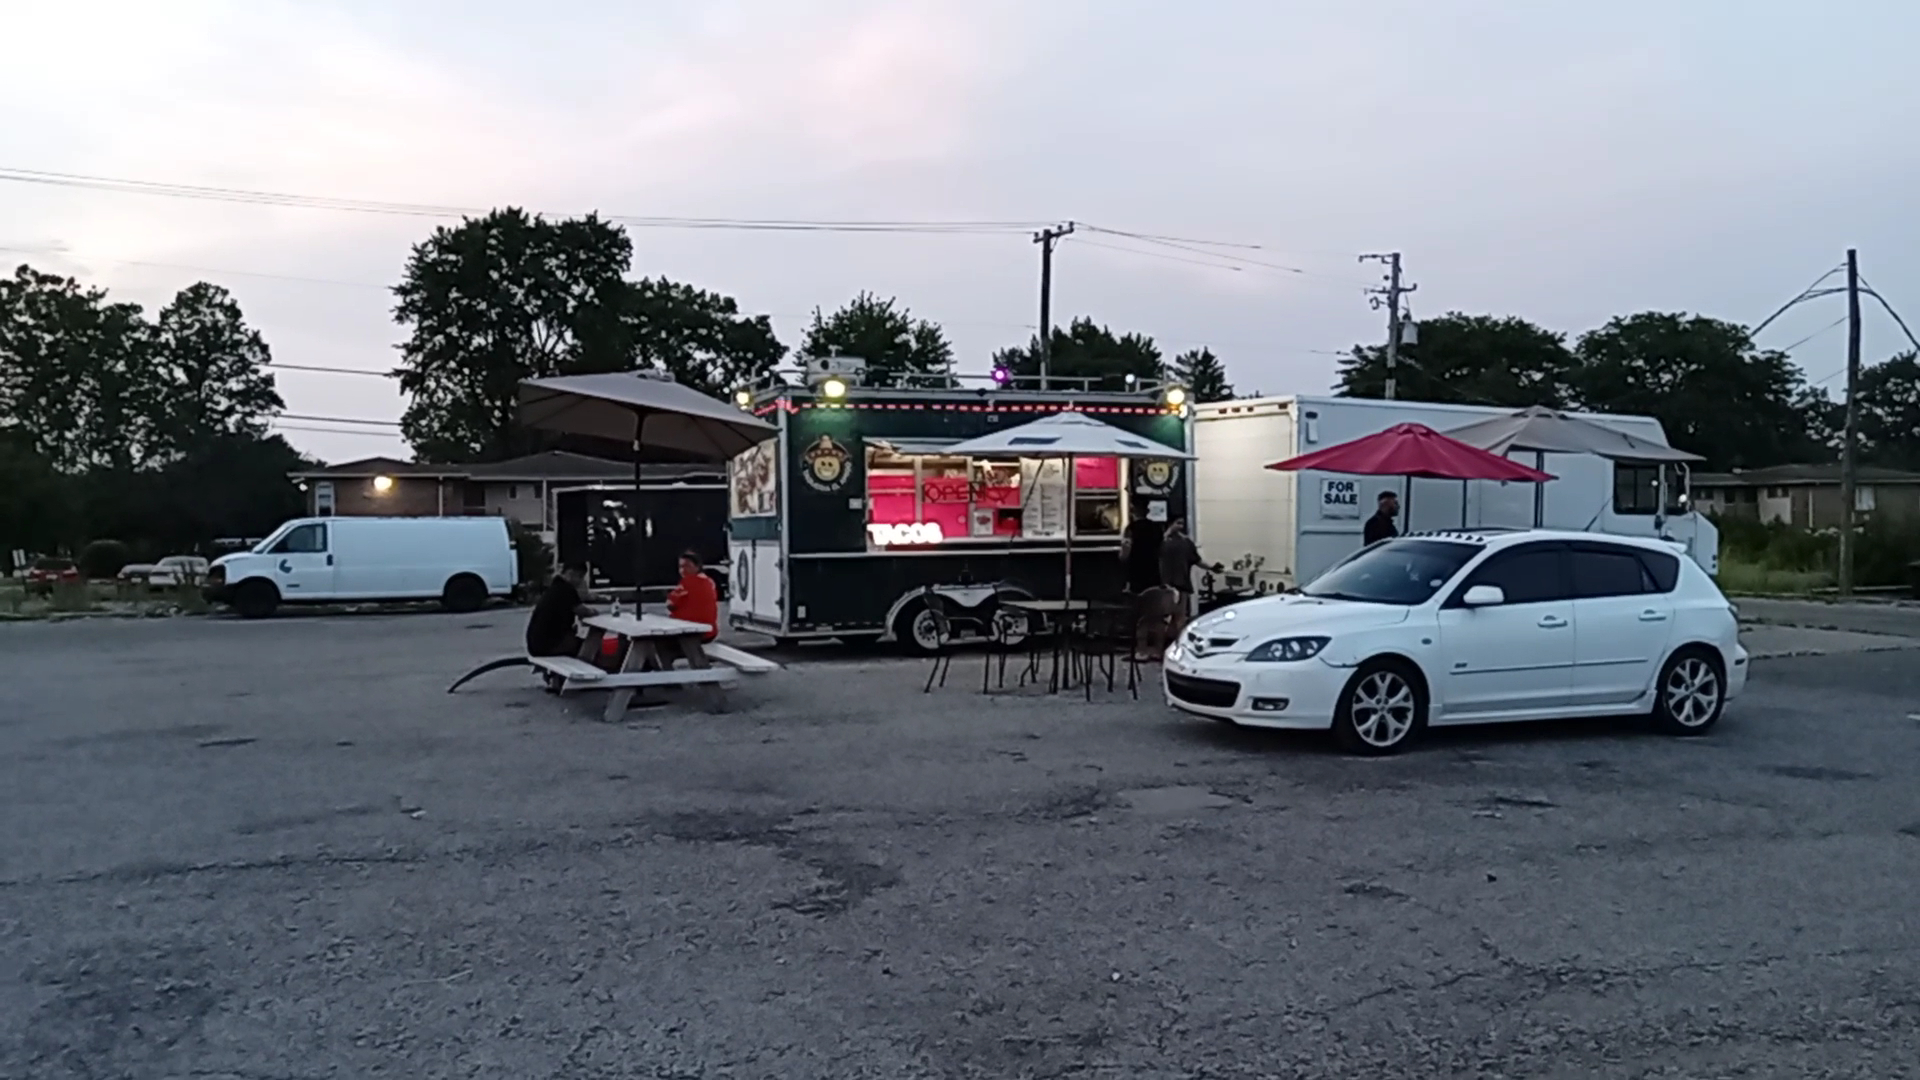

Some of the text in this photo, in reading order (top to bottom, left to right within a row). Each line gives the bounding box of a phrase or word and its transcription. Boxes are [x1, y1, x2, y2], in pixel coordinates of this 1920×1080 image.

[924, 482, 986, 502] OPEN
[1328, 481, 1354, 493] FOR
[1324, 493, 1358, 505] SALE
[867, 522, 943, 546] TACOS
